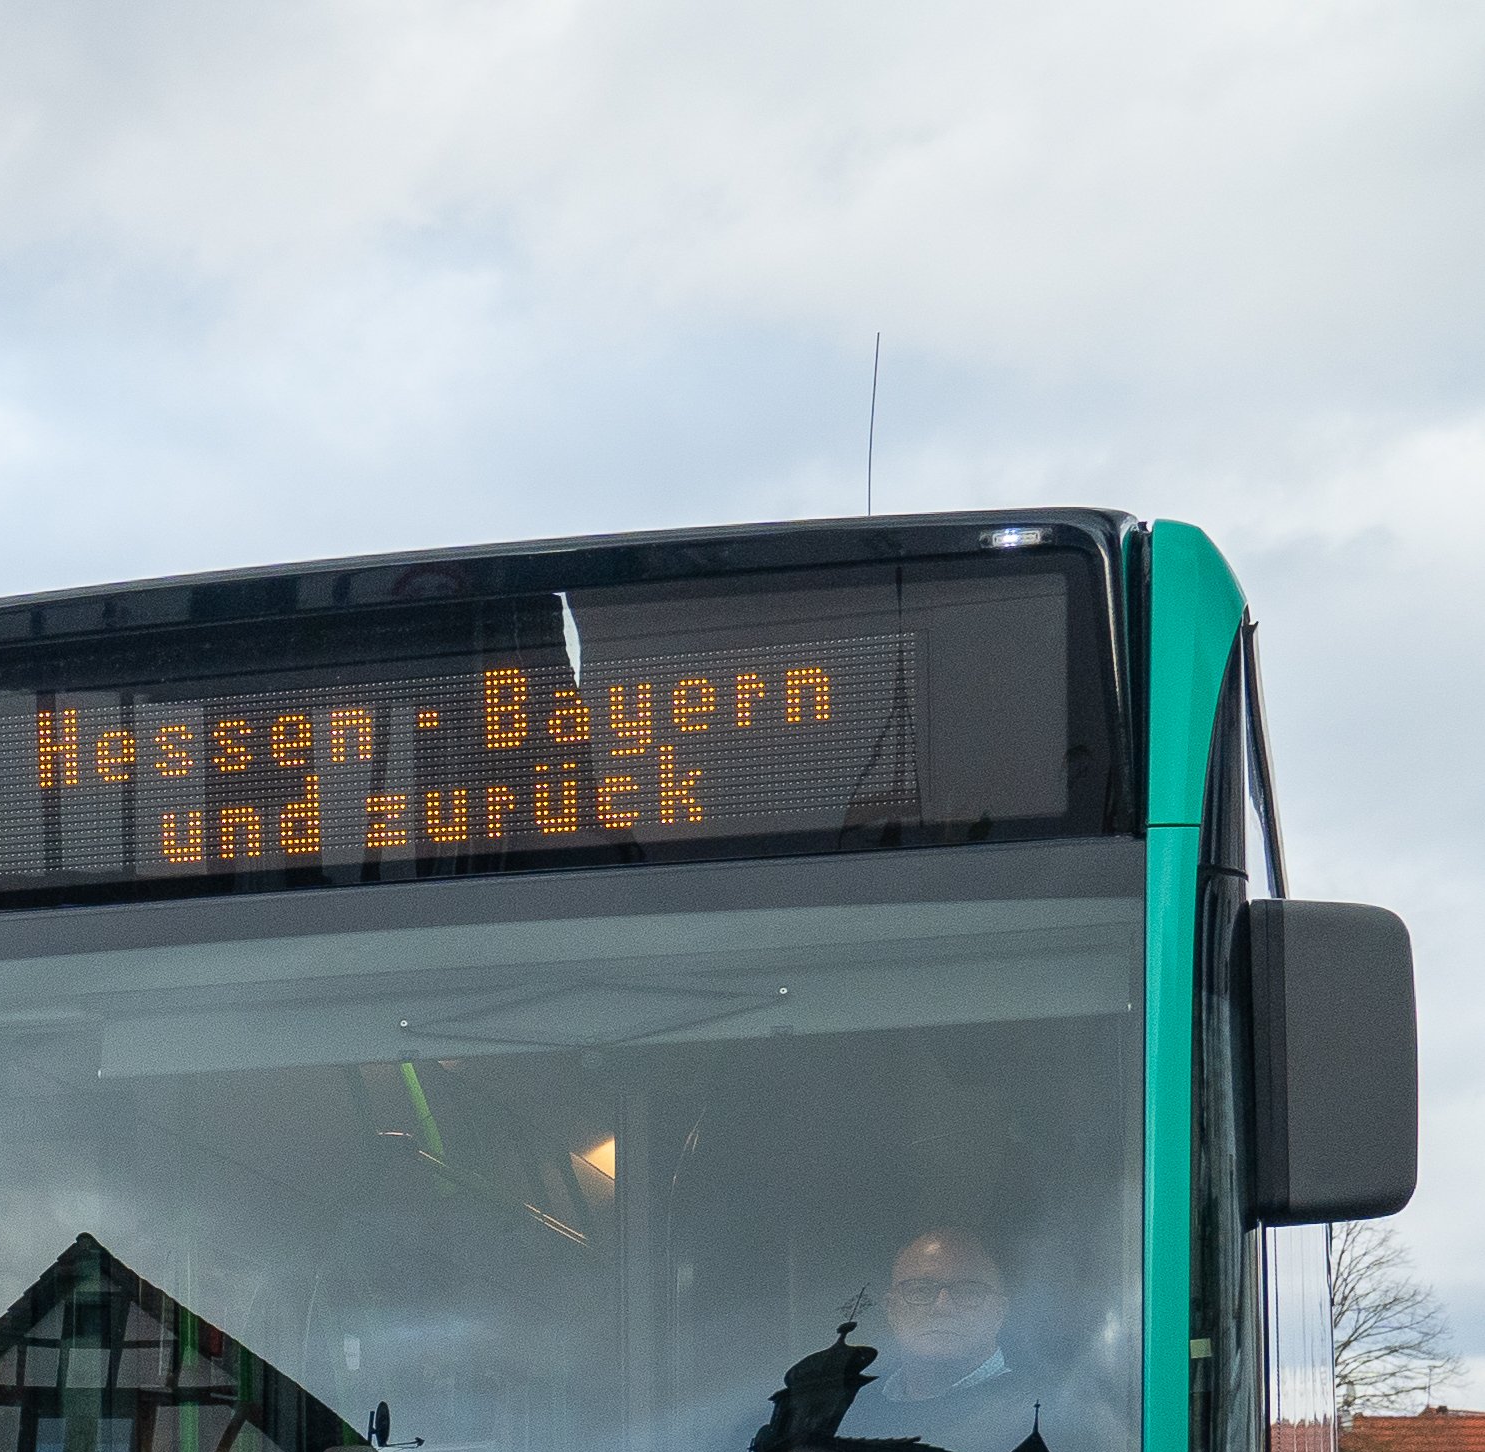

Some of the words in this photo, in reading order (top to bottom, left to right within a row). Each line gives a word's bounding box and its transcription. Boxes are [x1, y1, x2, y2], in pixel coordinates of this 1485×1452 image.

[38, 709, 372, 788] Hessen
[485, 667, 830, 756] Bayern
[162, 774, 320, 862] und
[366, 745, 702, 848] zurück
